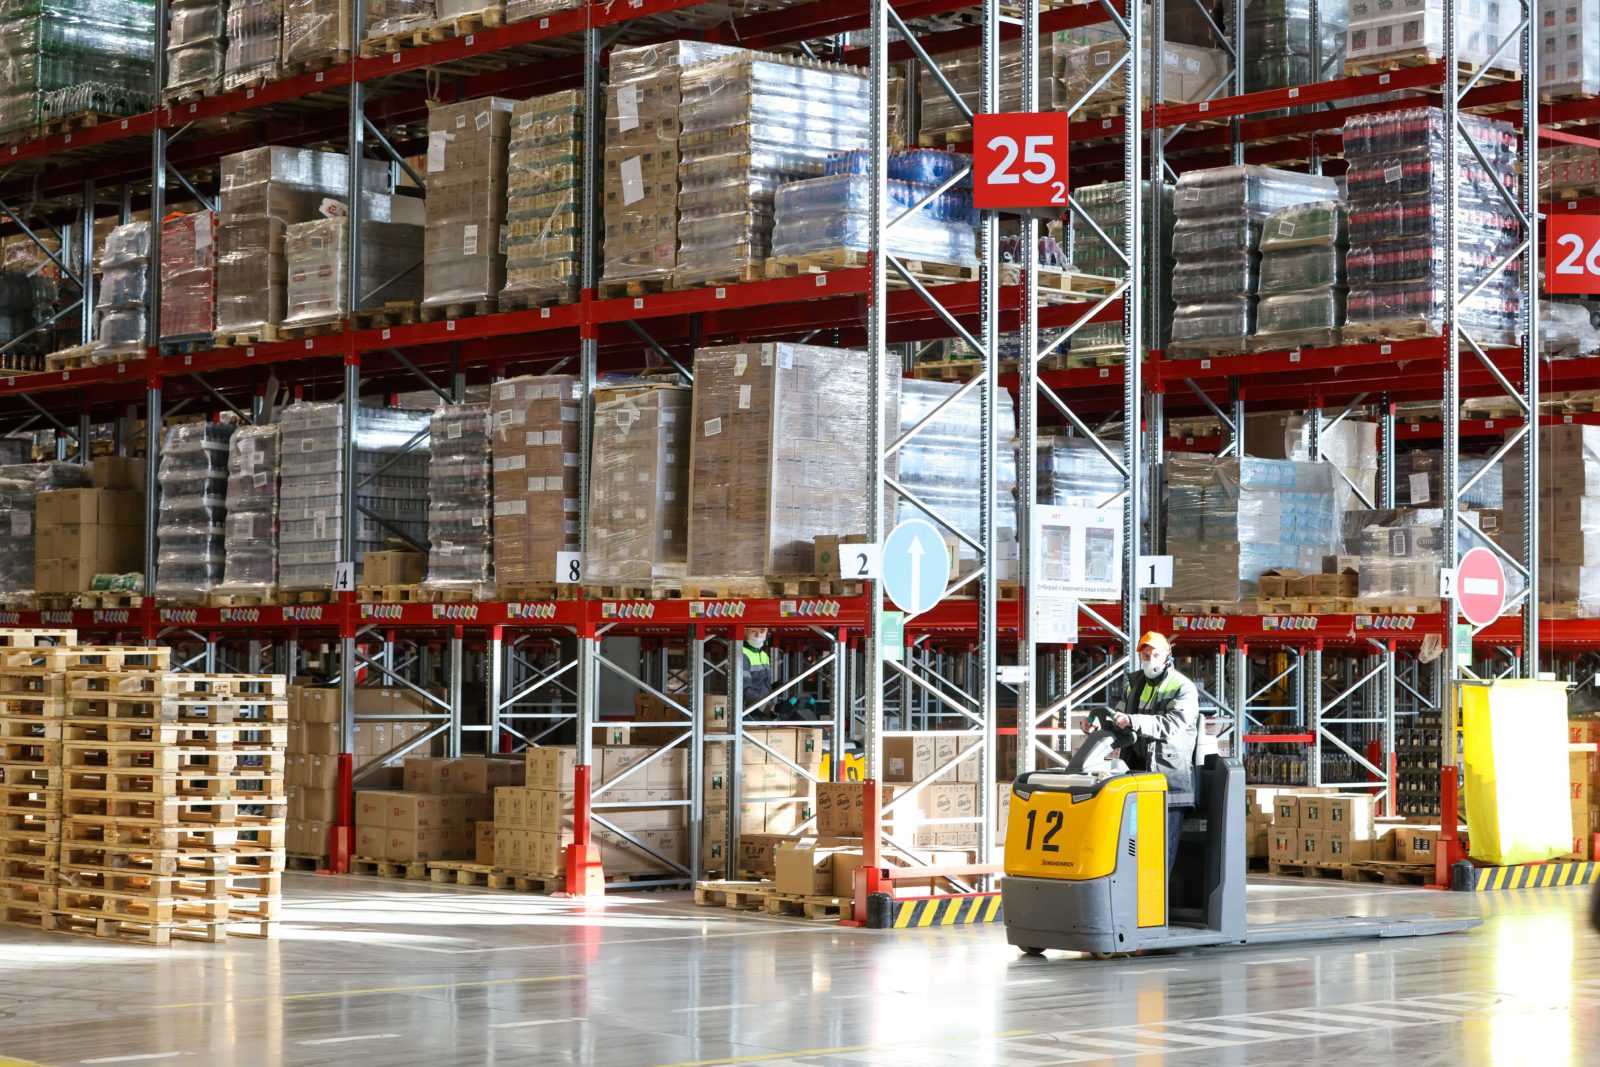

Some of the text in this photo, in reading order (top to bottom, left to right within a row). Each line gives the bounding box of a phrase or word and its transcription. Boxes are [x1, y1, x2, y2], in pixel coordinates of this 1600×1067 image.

[987, 135, 1066, 204] 25 2
[569, 559, 580, 582] 8
[856, 552, 869, 575] 2
[1148, 564, 1157, 585] 1
[335, 569, 348, 589] 14
[1026, 810, 1064, 852] 12
